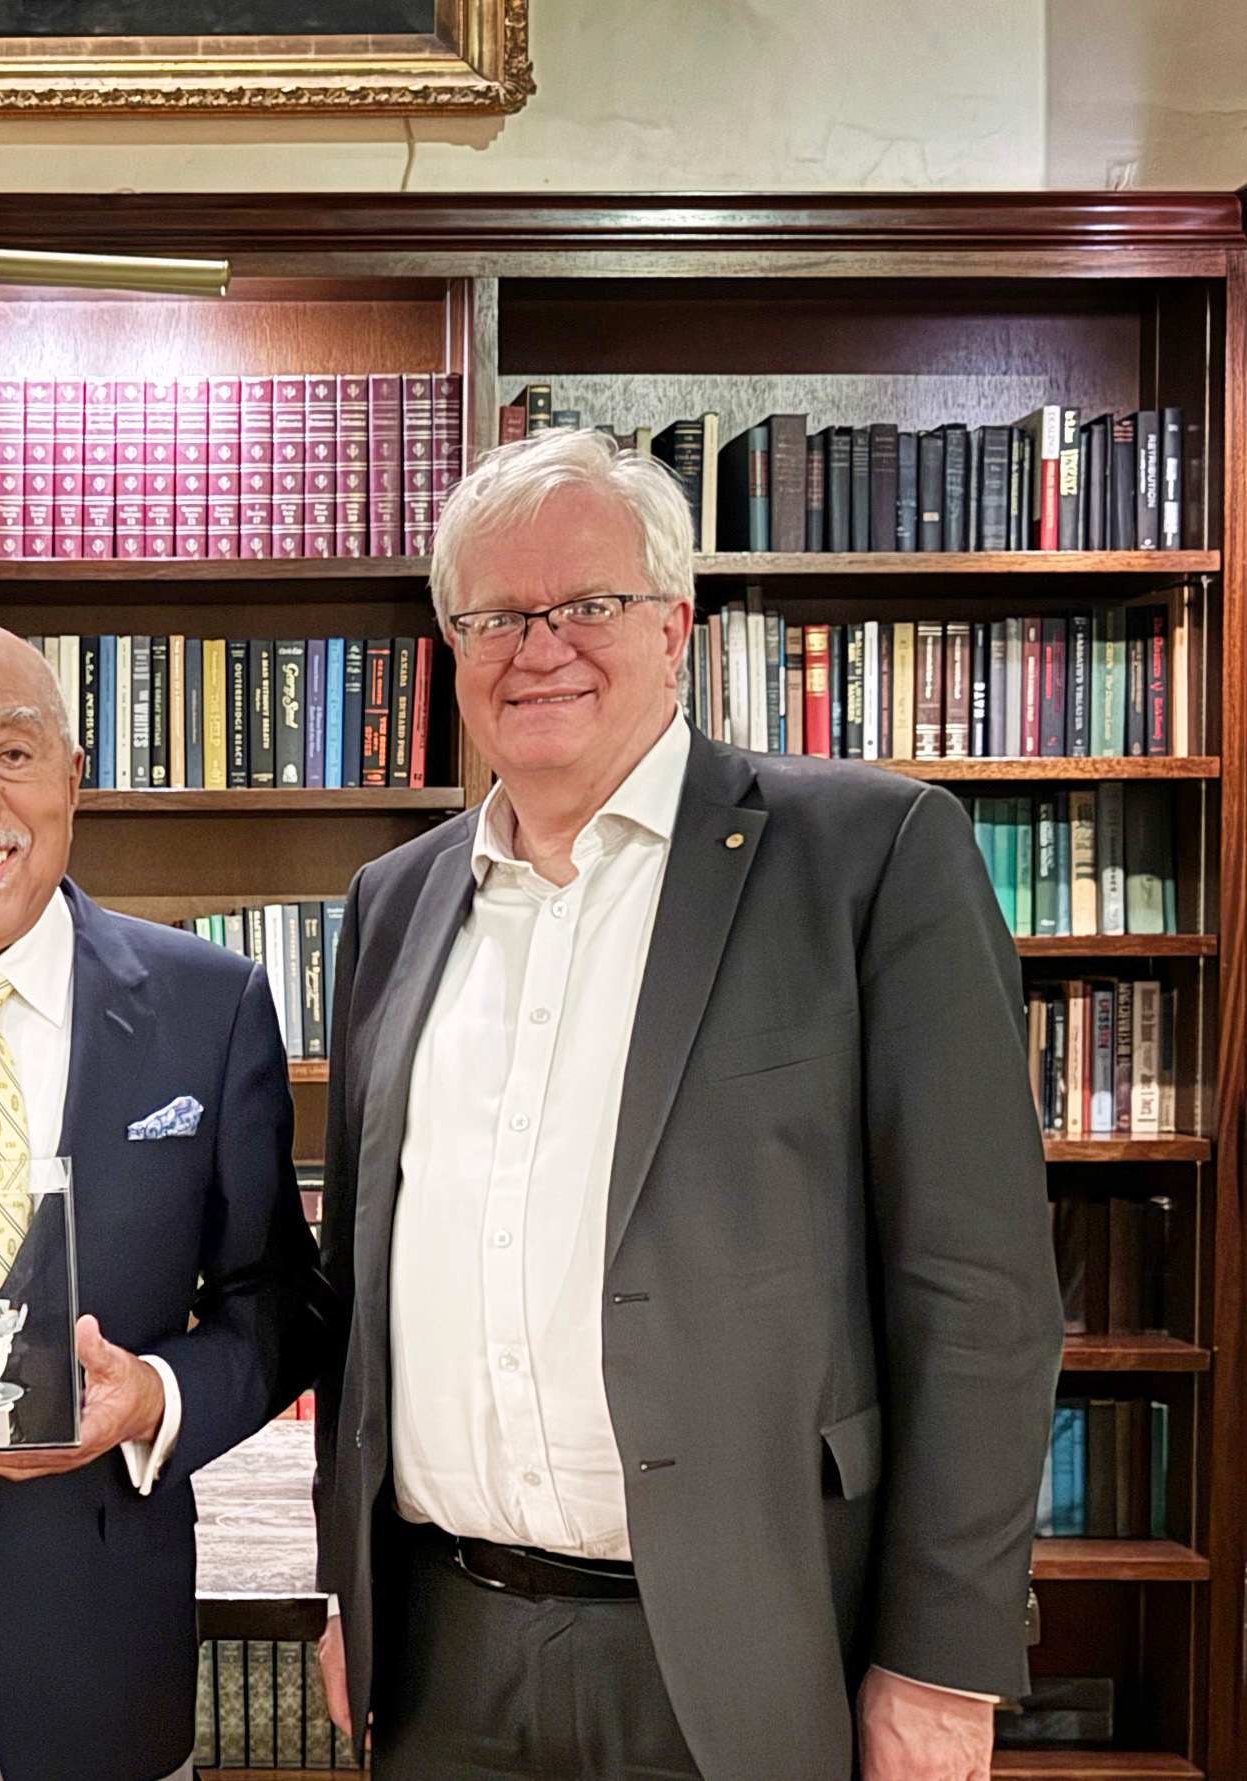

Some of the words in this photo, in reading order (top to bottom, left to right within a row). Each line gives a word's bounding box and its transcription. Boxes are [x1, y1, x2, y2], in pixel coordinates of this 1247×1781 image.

[1147, 434, 1157, 508] RETRIBUTION
[400, 649, 409, 688] CANADA
[234, 663, 243, 730] OUTERBRIDGE
[262, 679, 270, 716] WITHOUT
[133, 702, 149, 748] WHITES
[379, 716, 387, 734] THE
[398, 696, 407, 739] RICHARD
[234, 733, 243, 766] REACH
[364, 726, 373, 756] SPIES
[397, 740, 405, 765] FORD
